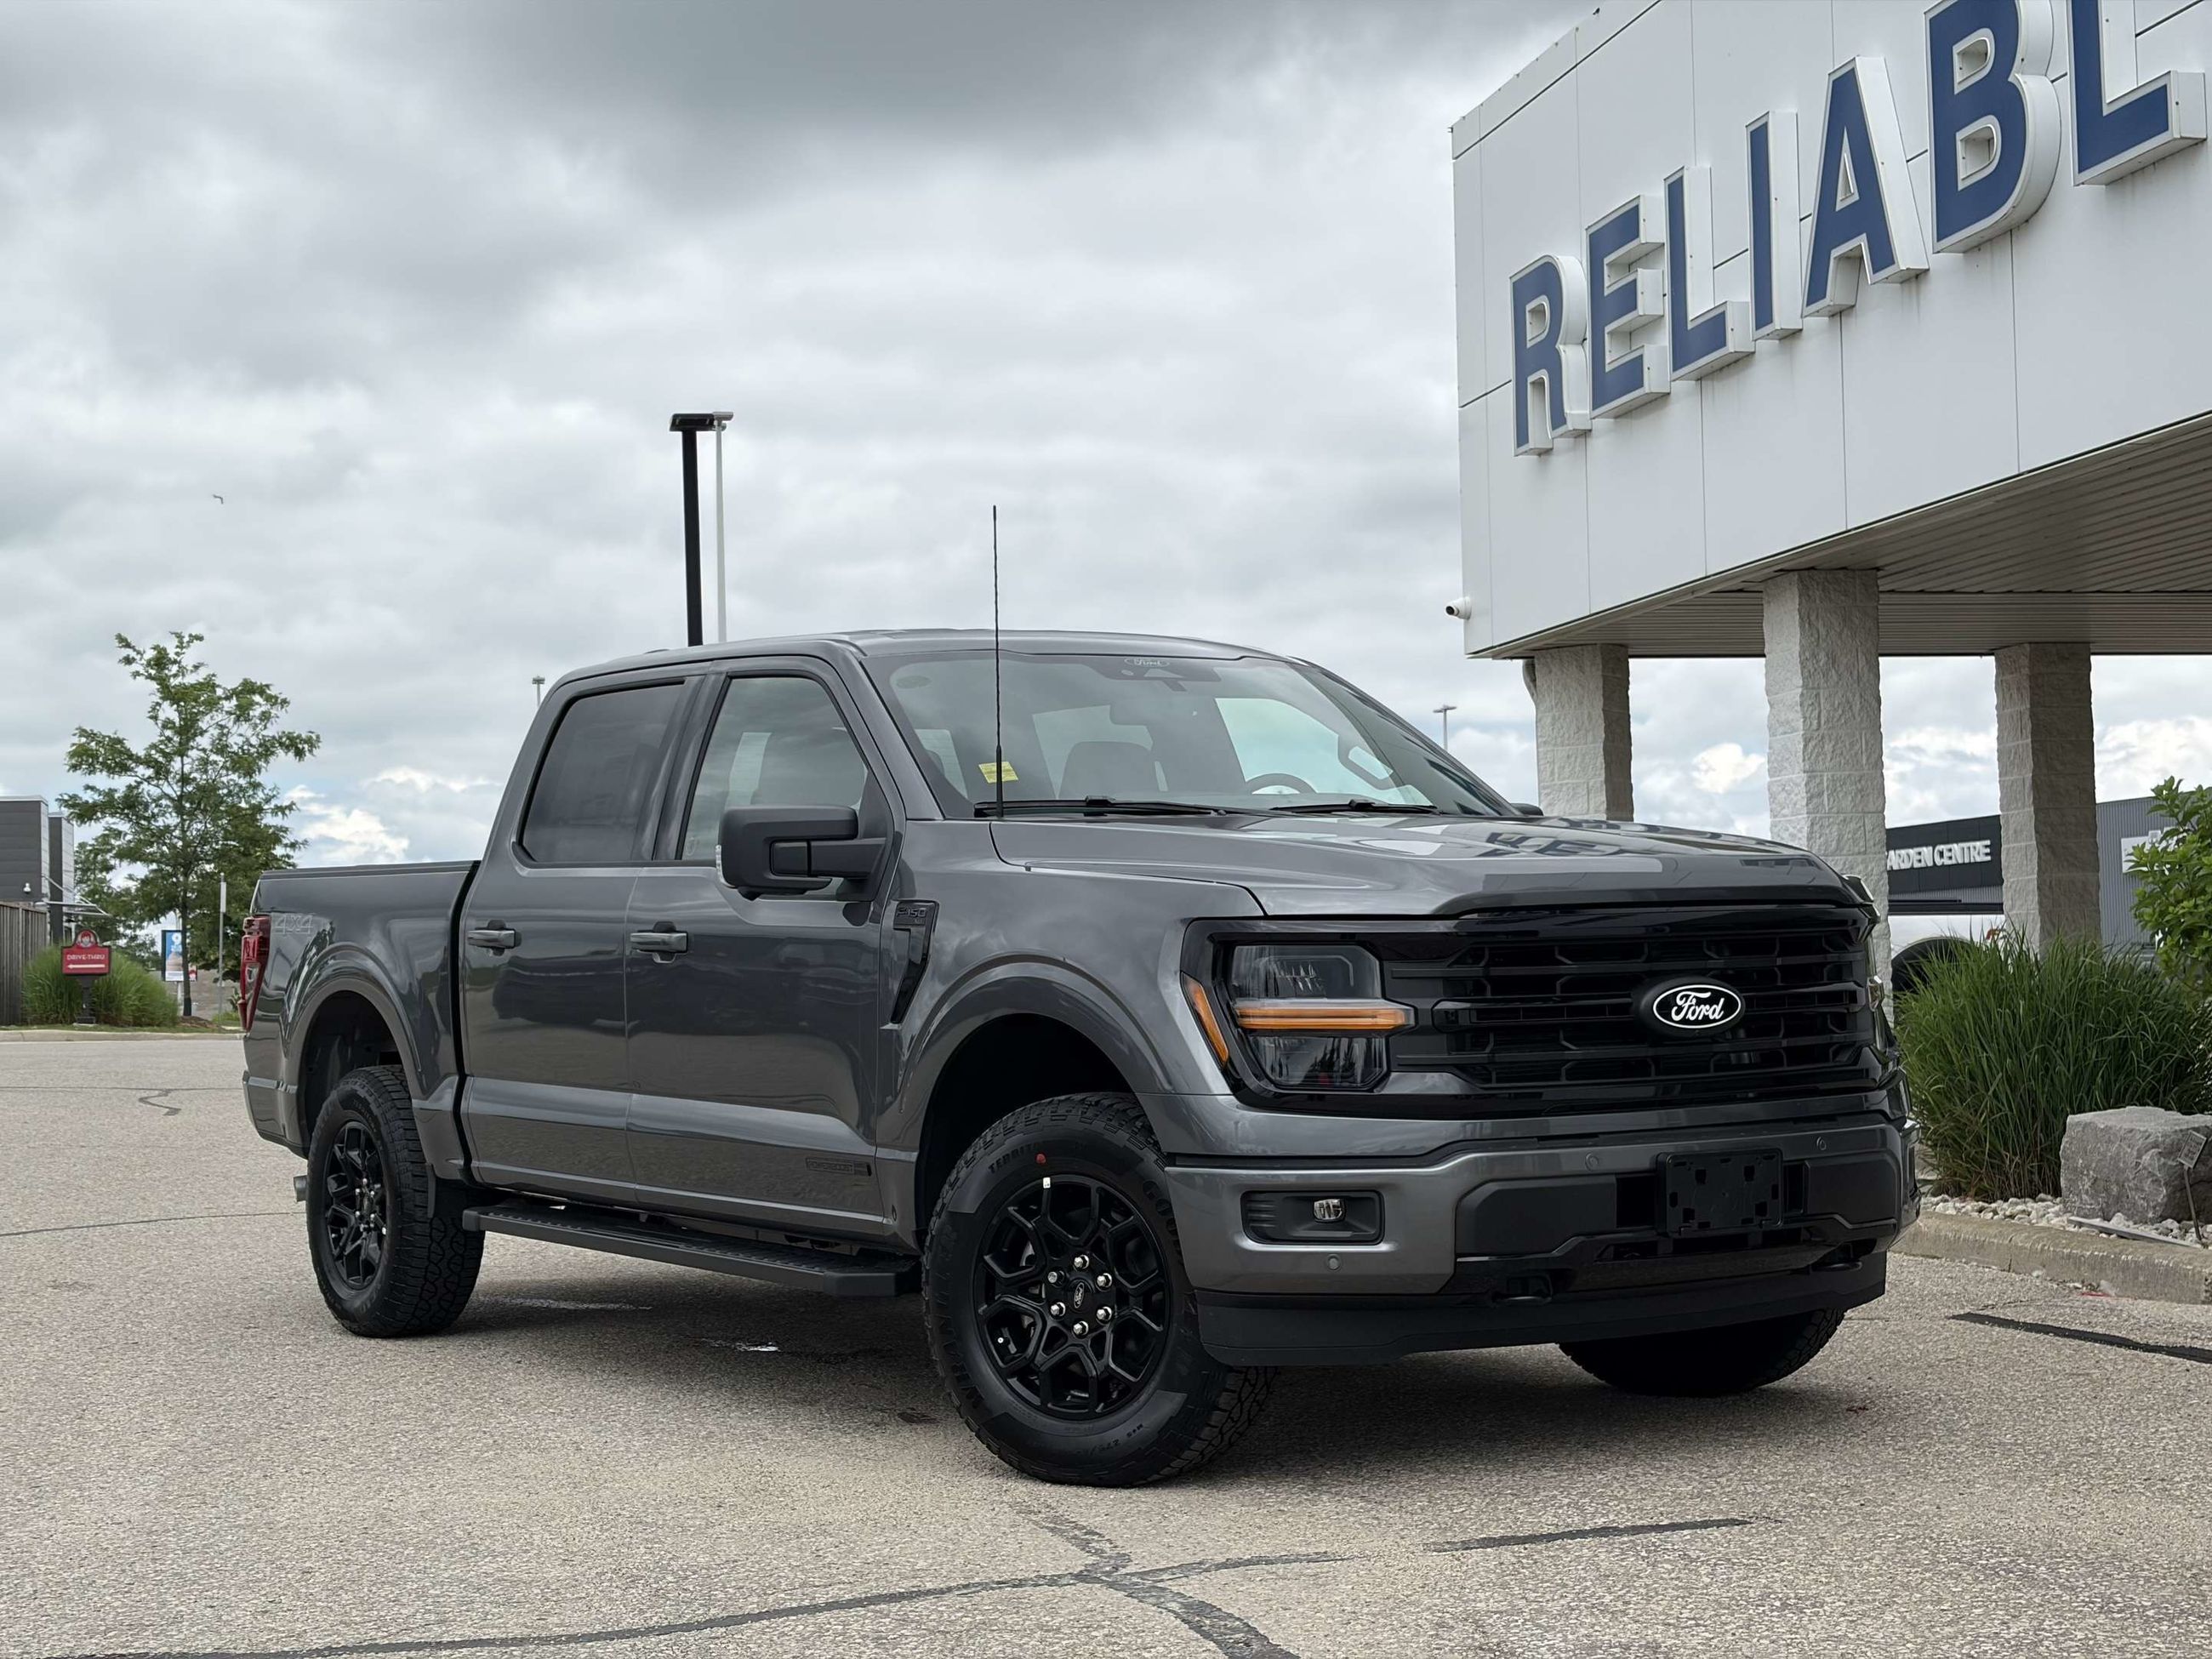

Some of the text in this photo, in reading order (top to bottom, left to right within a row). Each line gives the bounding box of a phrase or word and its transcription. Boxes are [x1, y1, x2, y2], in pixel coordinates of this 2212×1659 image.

[1510, 0, 2206, 457] RELIABL
[1885, 839, 1992, 871] ARDEN CENTRE
[1671, 990, 1725, 1021] Ford
